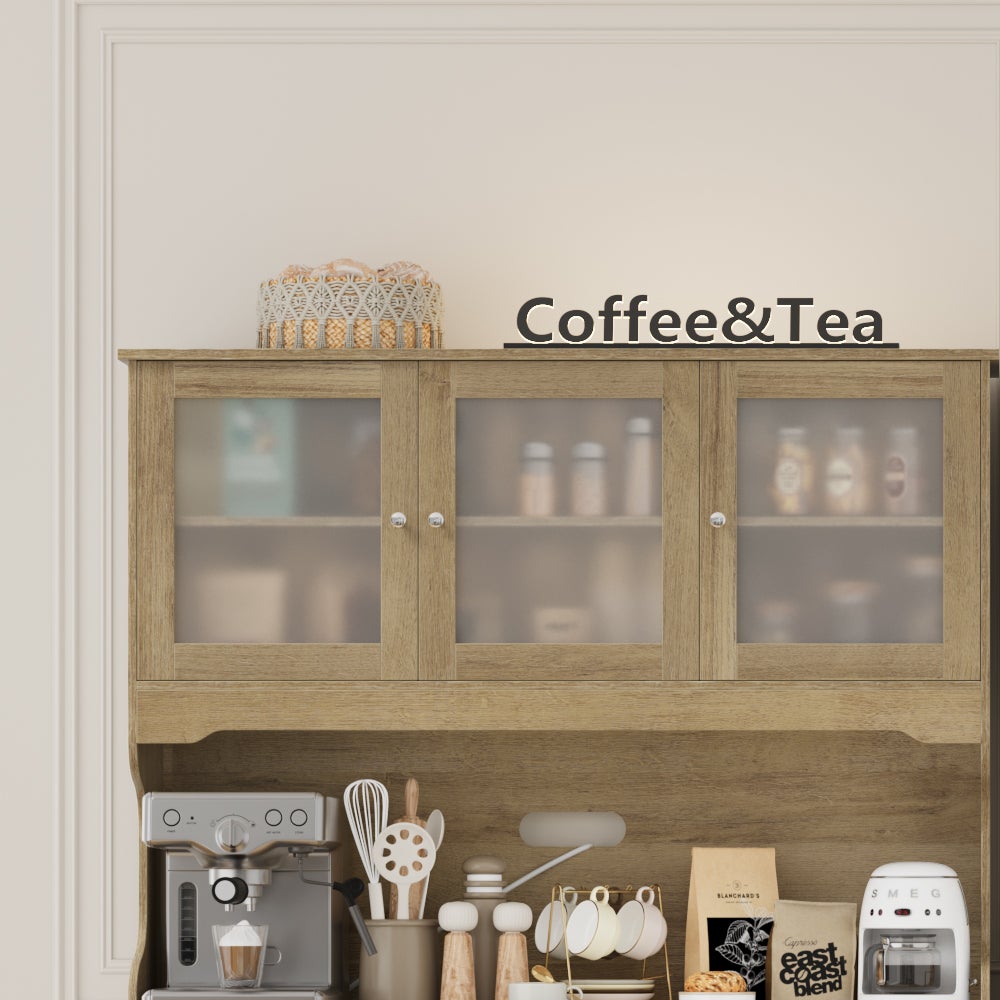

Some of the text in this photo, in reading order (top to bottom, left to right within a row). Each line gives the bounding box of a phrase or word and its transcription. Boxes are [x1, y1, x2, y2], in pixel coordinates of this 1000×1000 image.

[516, 294, 884, 344] Coffee&Tea
[871, 888, 941, 898] SMEG
[779, 955, 848, 985] coast
[780, 942, 838, 970] east
[793, 974, 843, 997] blend
